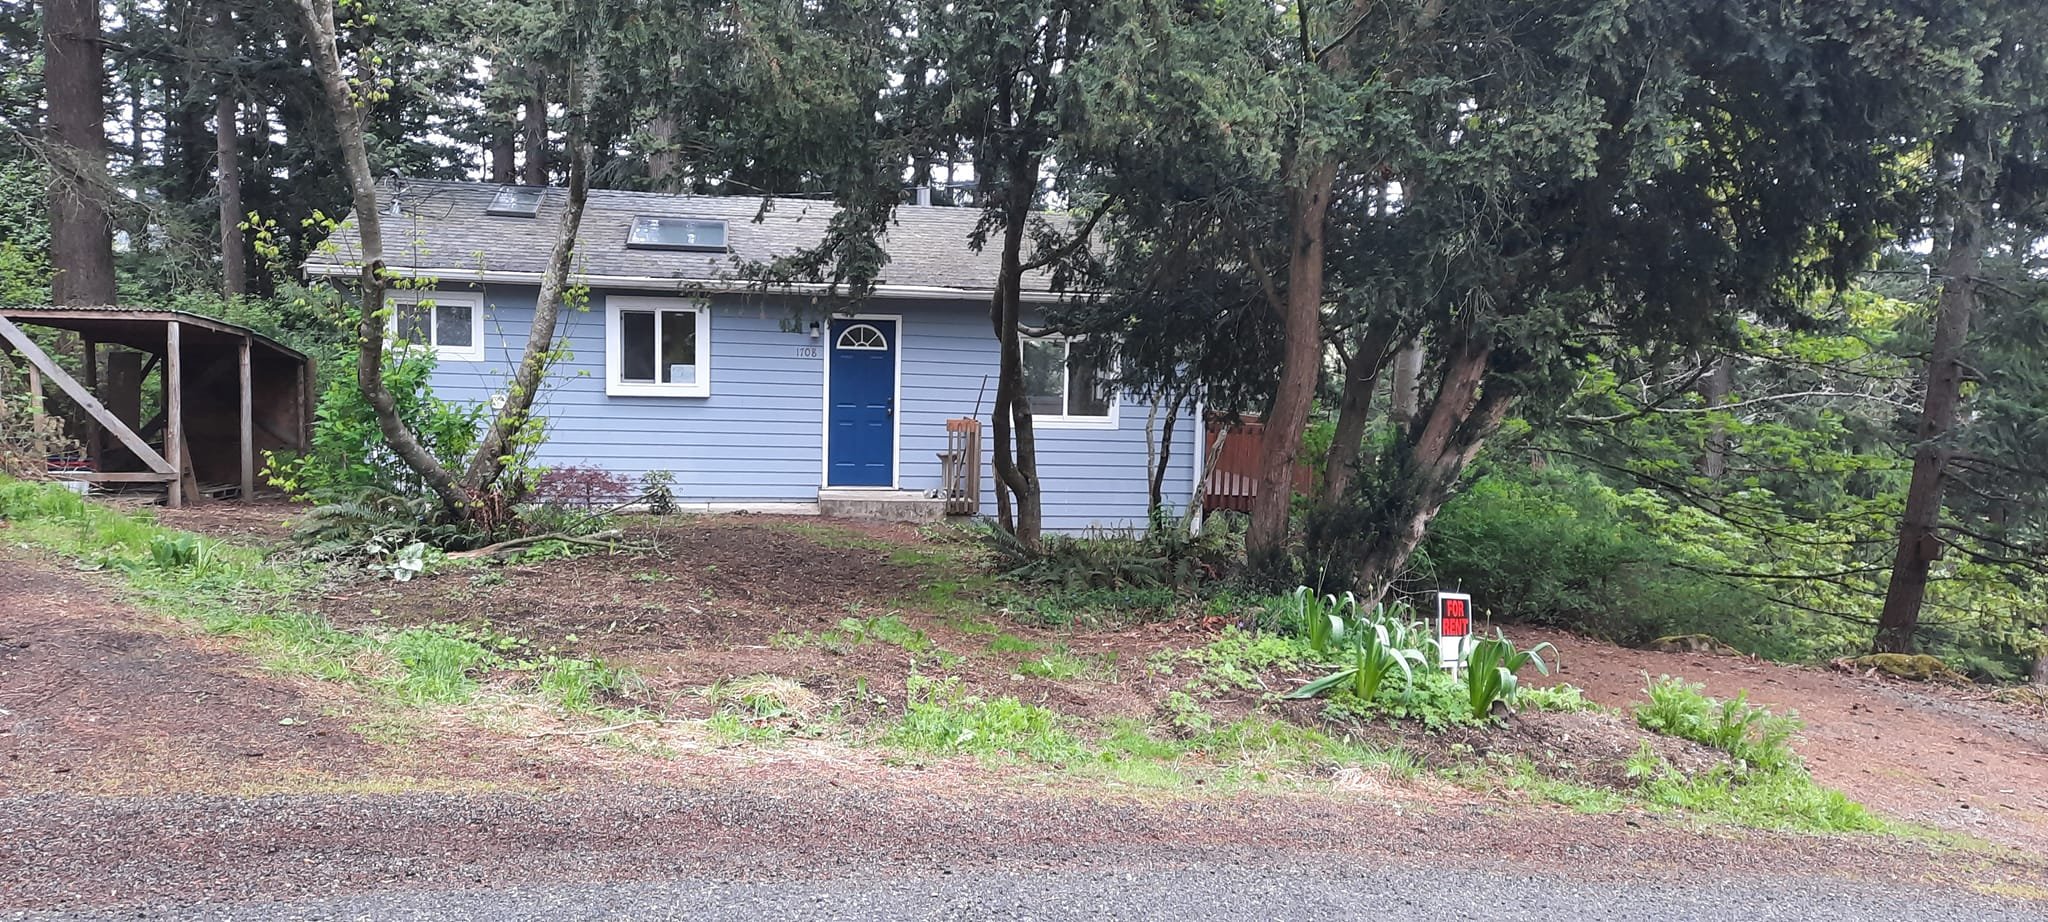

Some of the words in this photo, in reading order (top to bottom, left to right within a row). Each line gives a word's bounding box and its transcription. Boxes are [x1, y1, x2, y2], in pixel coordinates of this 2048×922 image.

[796, 347, 817, 358] 1708
[1446, 600, 1464, 617] FOR
[1443, 618, 1468, 635] RENT
